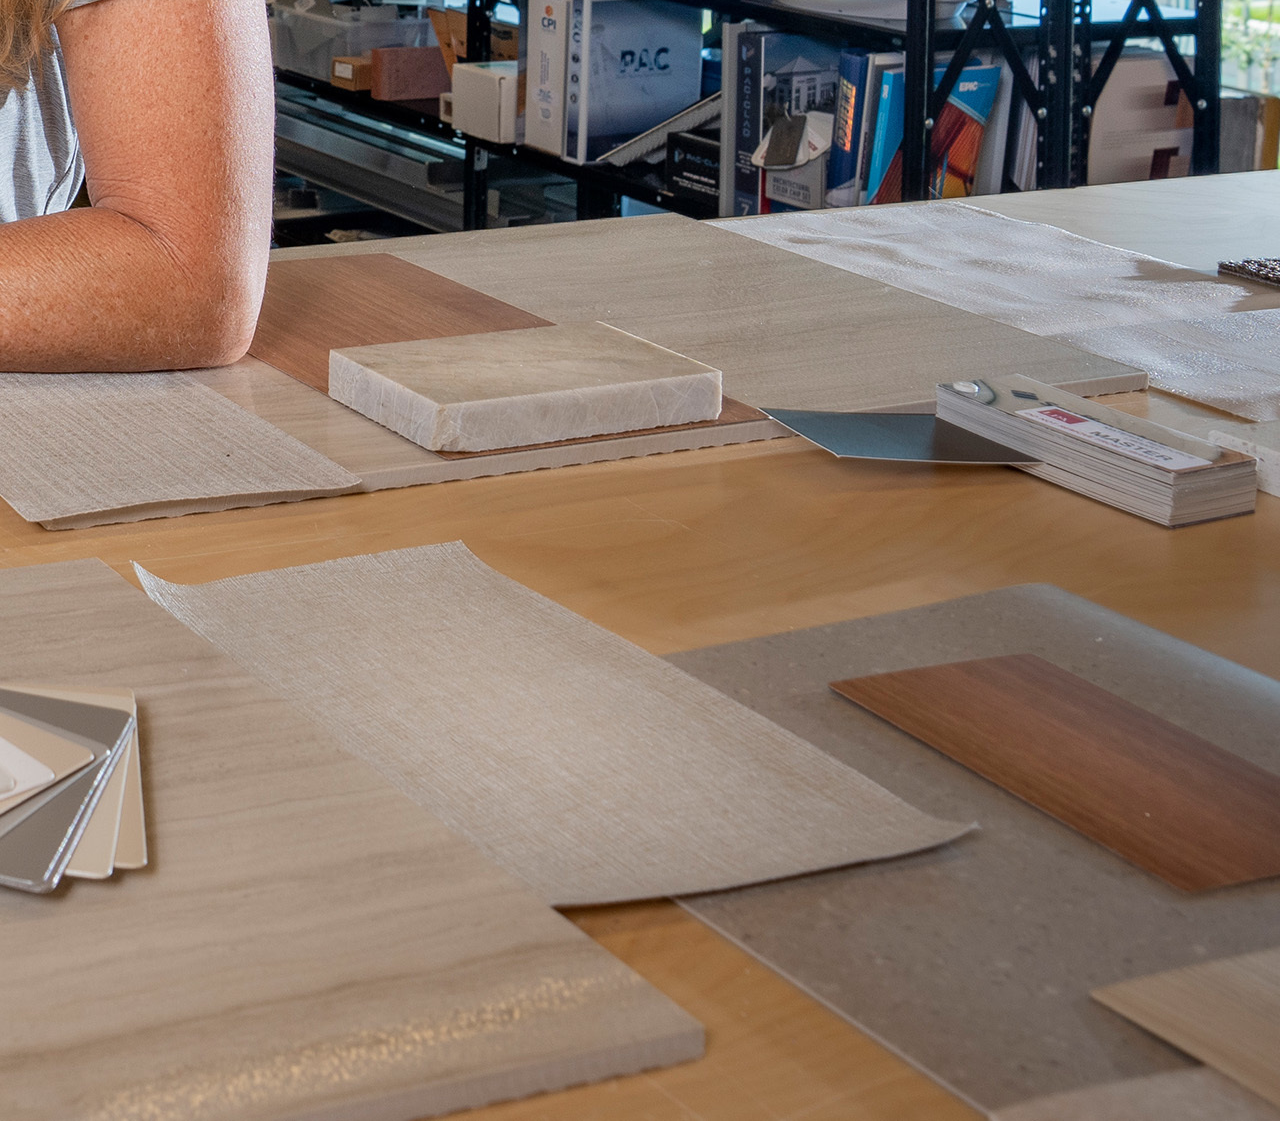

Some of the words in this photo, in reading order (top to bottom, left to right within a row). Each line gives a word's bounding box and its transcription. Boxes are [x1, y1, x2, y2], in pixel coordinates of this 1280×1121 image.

[541, 17, 557, 30] CPI
[620, 46, 670, 73] PAC
[1090, 431, 1174, 462] MASTER
